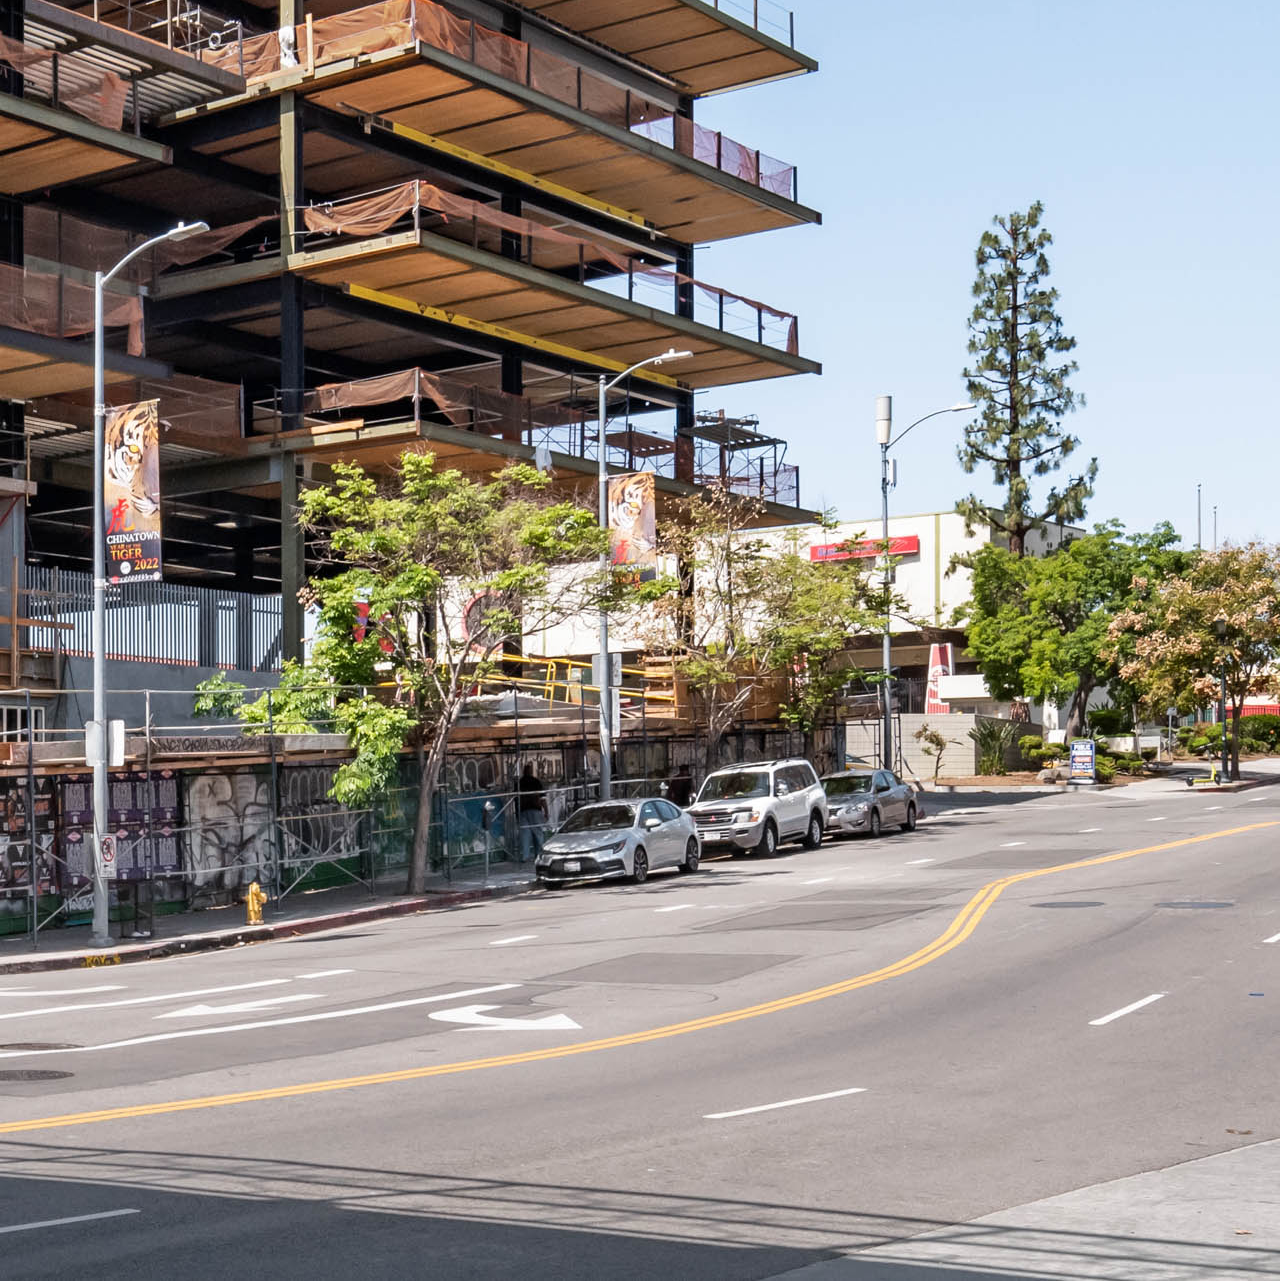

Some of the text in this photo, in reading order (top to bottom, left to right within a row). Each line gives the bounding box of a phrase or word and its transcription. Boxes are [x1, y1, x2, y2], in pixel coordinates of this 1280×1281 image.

[106, 530, 160, 544] CHINATOWN
[110, 548, 142, 561] TIGER
[134, 558, 158, 570] 2022
